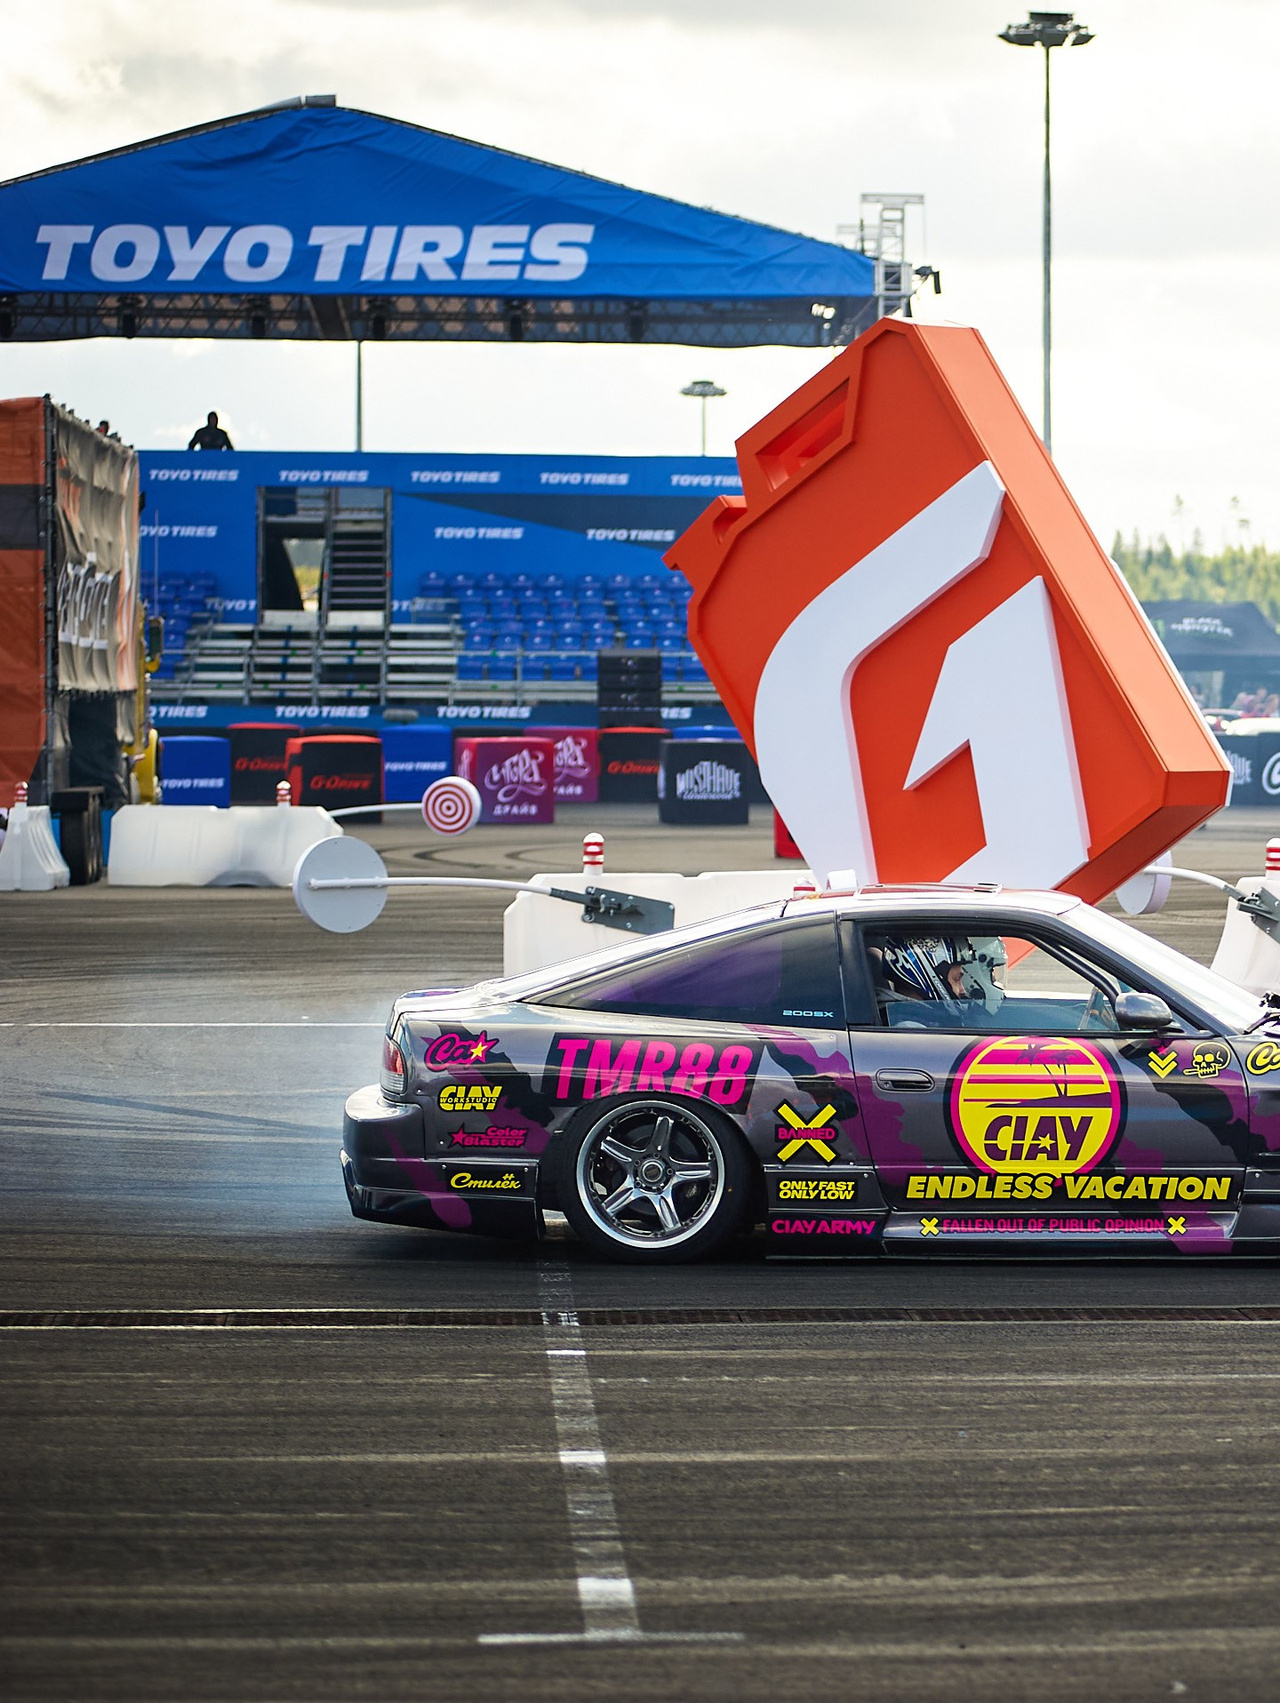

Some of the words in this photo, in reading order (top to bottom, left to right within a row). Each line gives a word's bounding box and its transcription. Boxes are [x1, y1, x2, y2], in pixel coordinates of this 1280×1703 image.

[35, 224, 293, 283] TOYO
[307, 223, 595, 283] TIRES
[149, 469, 188, 482] TOYO
[191, 469, 239, 482] TIRES
[279, 470, 318, 483] TOYO
[321, 470, 369, 483] TIRES
[410, 471, 451, 483] TOYO
[454, 471, 500, 483] TIRES
[540, 472, 579, 485] TOYO
[582, 472, 629, 485] TIRES
[714, 475, 742, 487] TIR
[140, 525, 170, 537] OYO
[171, 525, 218, 537] TIRES
[434, 527, 475, 540] TOYO
[478, 527, 524, 540] TIRES
[586, 529, 626, 542] TOYO
[628, 529, 675, 542] TIRES
[158, 705, 208, 718] TIRES
[275, 705, 320, 718] TOYO
[322, 705, 370, 718] TIRES
[437, 706, 481, 719] TOYO
[482, 706, 532, 719] TIRES
[782, 1009, 834, 1018] 200SX
[556, 1038, 755, 1106] TMR88
[486, 1127, 527, 1137] Color
[778, 1127, 836, 1140] BANNED
[464, 1136, 525, 1147] Blaster
[779, 1181, 818, 1190] ONLY
[819, 1181, 855, 1191] FAST
[906, 1174, 1054, 1199] ENDLESS
[1064, 1175, 1232, 1200] VACATION
[779, 1190, 819, 1199] ONLY
[820, 1190, 855, 1200] LOW
[816, 1220, 876, 1235] ARMY
[942, 1218, 994, 1233] FALLEN
[997, 1218, 1026, 1233] OUT
[1028, 1218, 1047, 1233] OF
[1049, 1218, 1101, 1233] PUBLIC
[1104, 1218, 1165, 1233] OPINION
